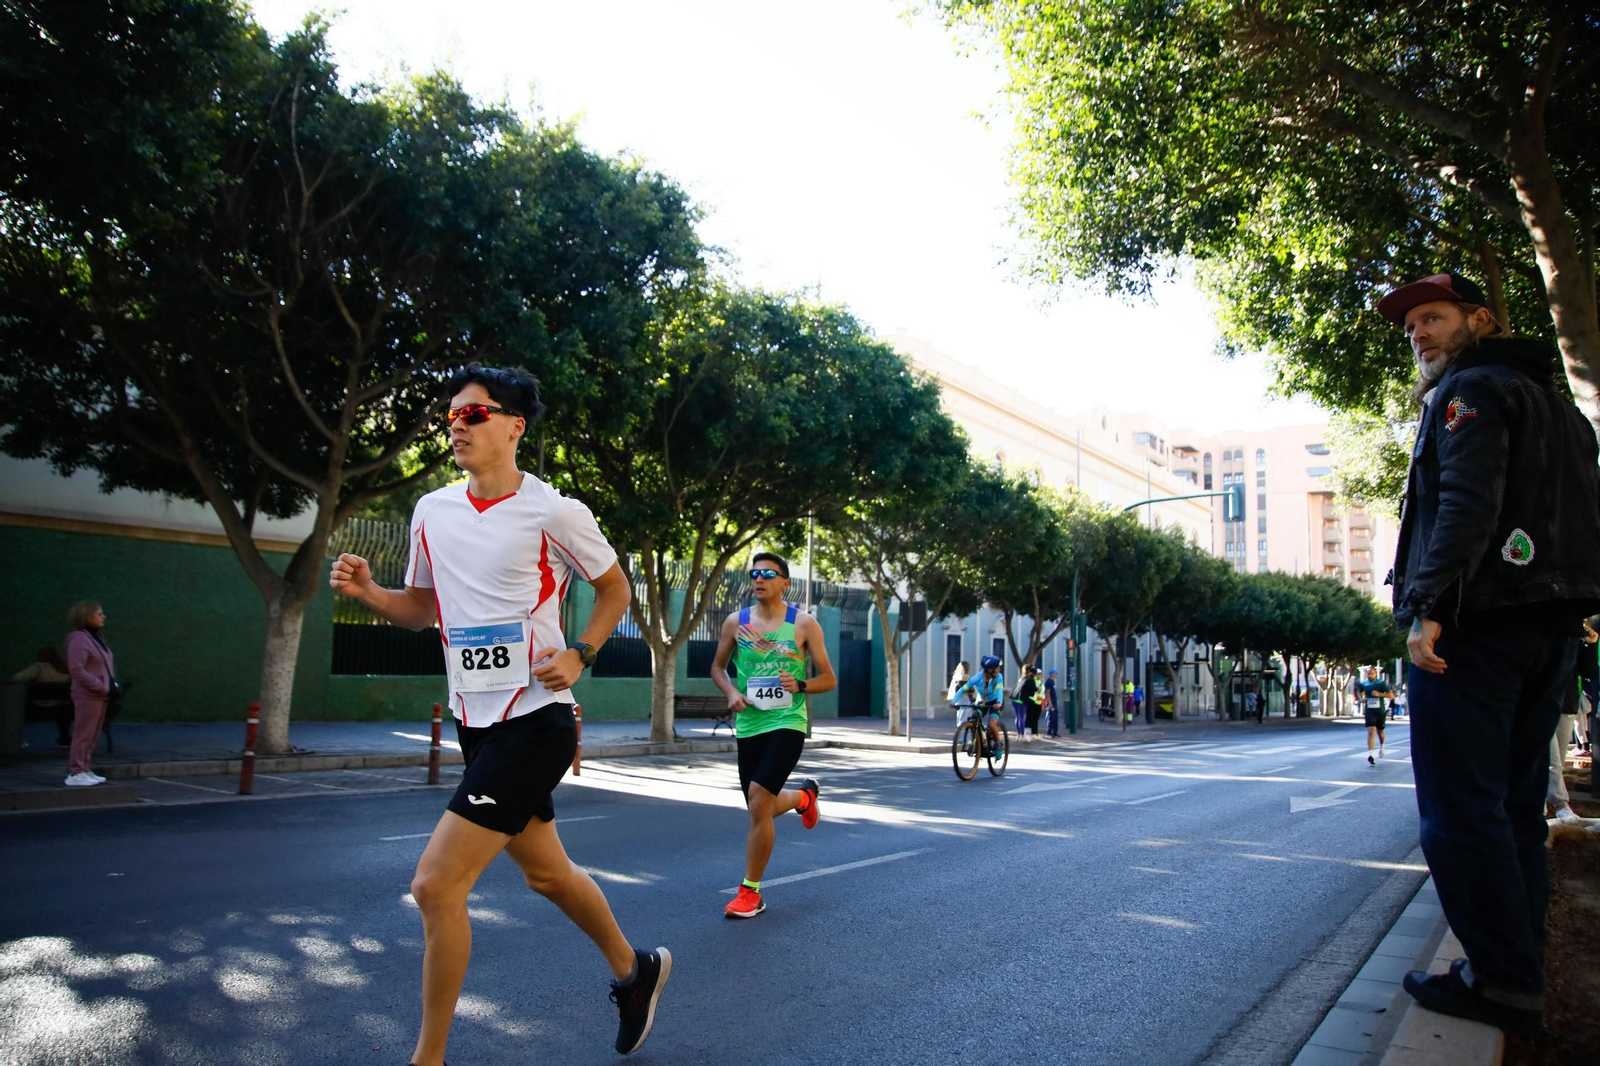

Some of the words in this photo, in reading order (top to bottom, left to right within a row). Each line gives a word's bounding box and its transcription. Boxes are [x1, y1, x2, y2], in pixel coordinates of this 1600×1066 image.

[461, 646, 511, 671] 828
[755, 661, 791, 670] SAKATA
[755, 687, 784, 700] 446
